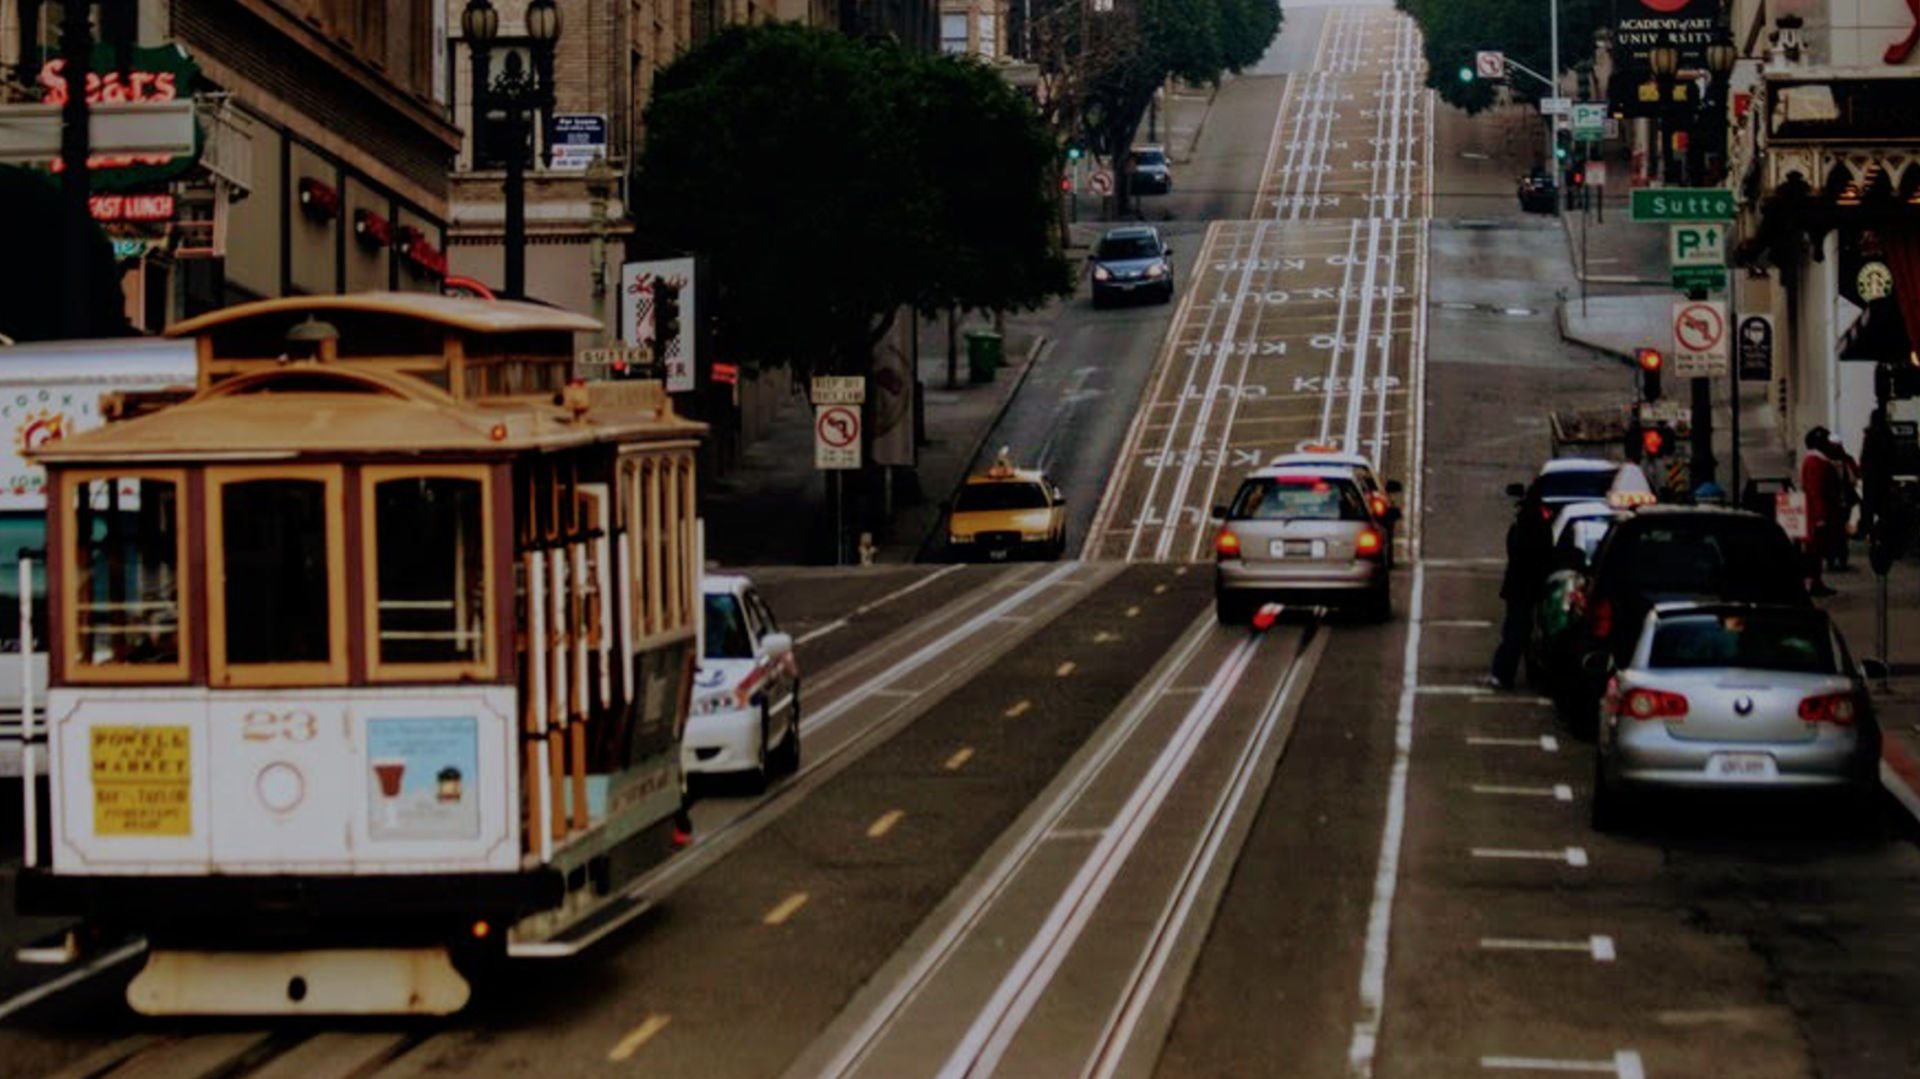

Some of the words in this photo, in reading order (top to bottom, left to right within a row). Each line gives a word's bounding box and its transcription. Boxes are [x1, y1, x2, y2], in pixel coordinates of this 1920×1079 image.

[1619, 19, 1680, 29] ACADEMY
[1618, 33, 1712, 44] UNIVRSITY
[1678, 230, 1699, 259] P
[243, 710, 319, 742] 23
[94, 733, 185, 749] POWELL
[94, 760, 186, 773] MARKET
